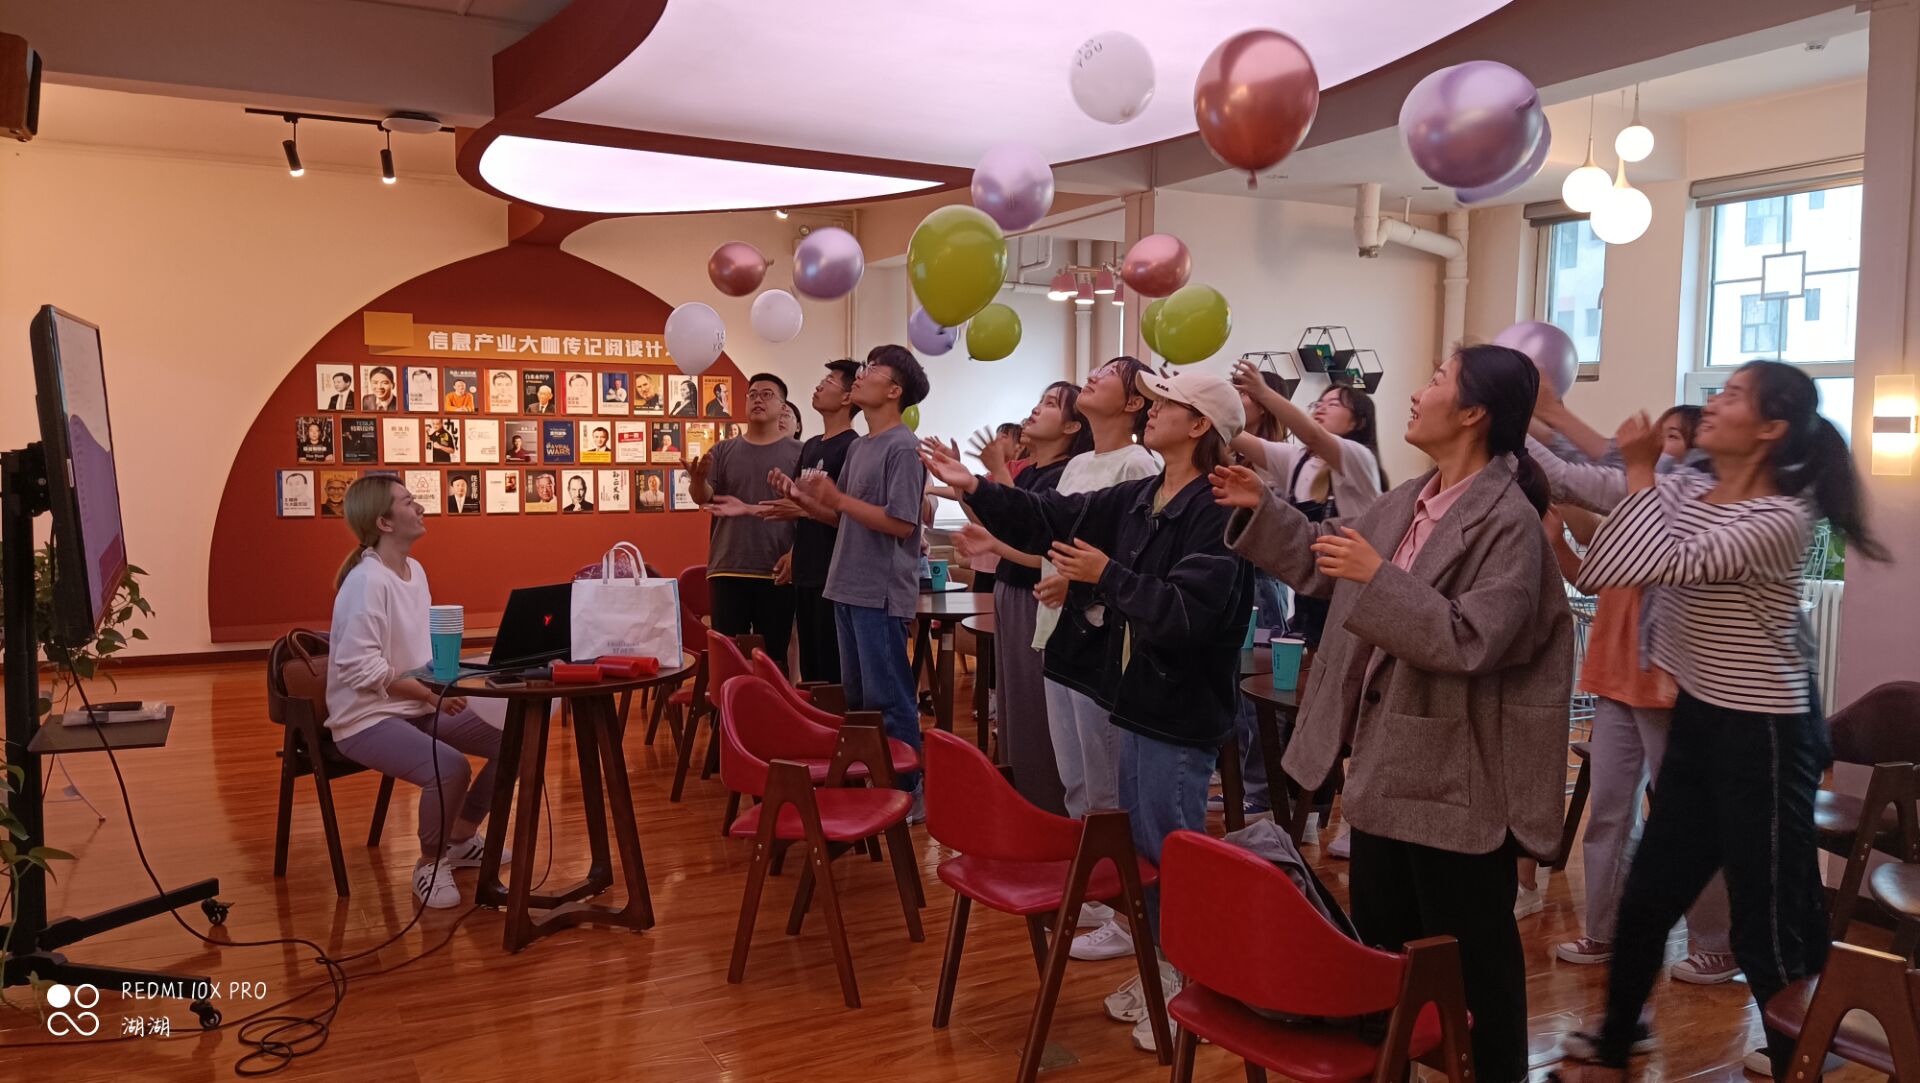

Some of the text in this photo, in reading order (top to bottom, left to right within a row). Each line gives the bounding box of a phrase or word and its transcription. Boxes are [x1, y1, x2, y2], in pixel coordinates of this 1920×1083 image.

[427, 331, 671, 359] 信息产业大咖传记阅读计
